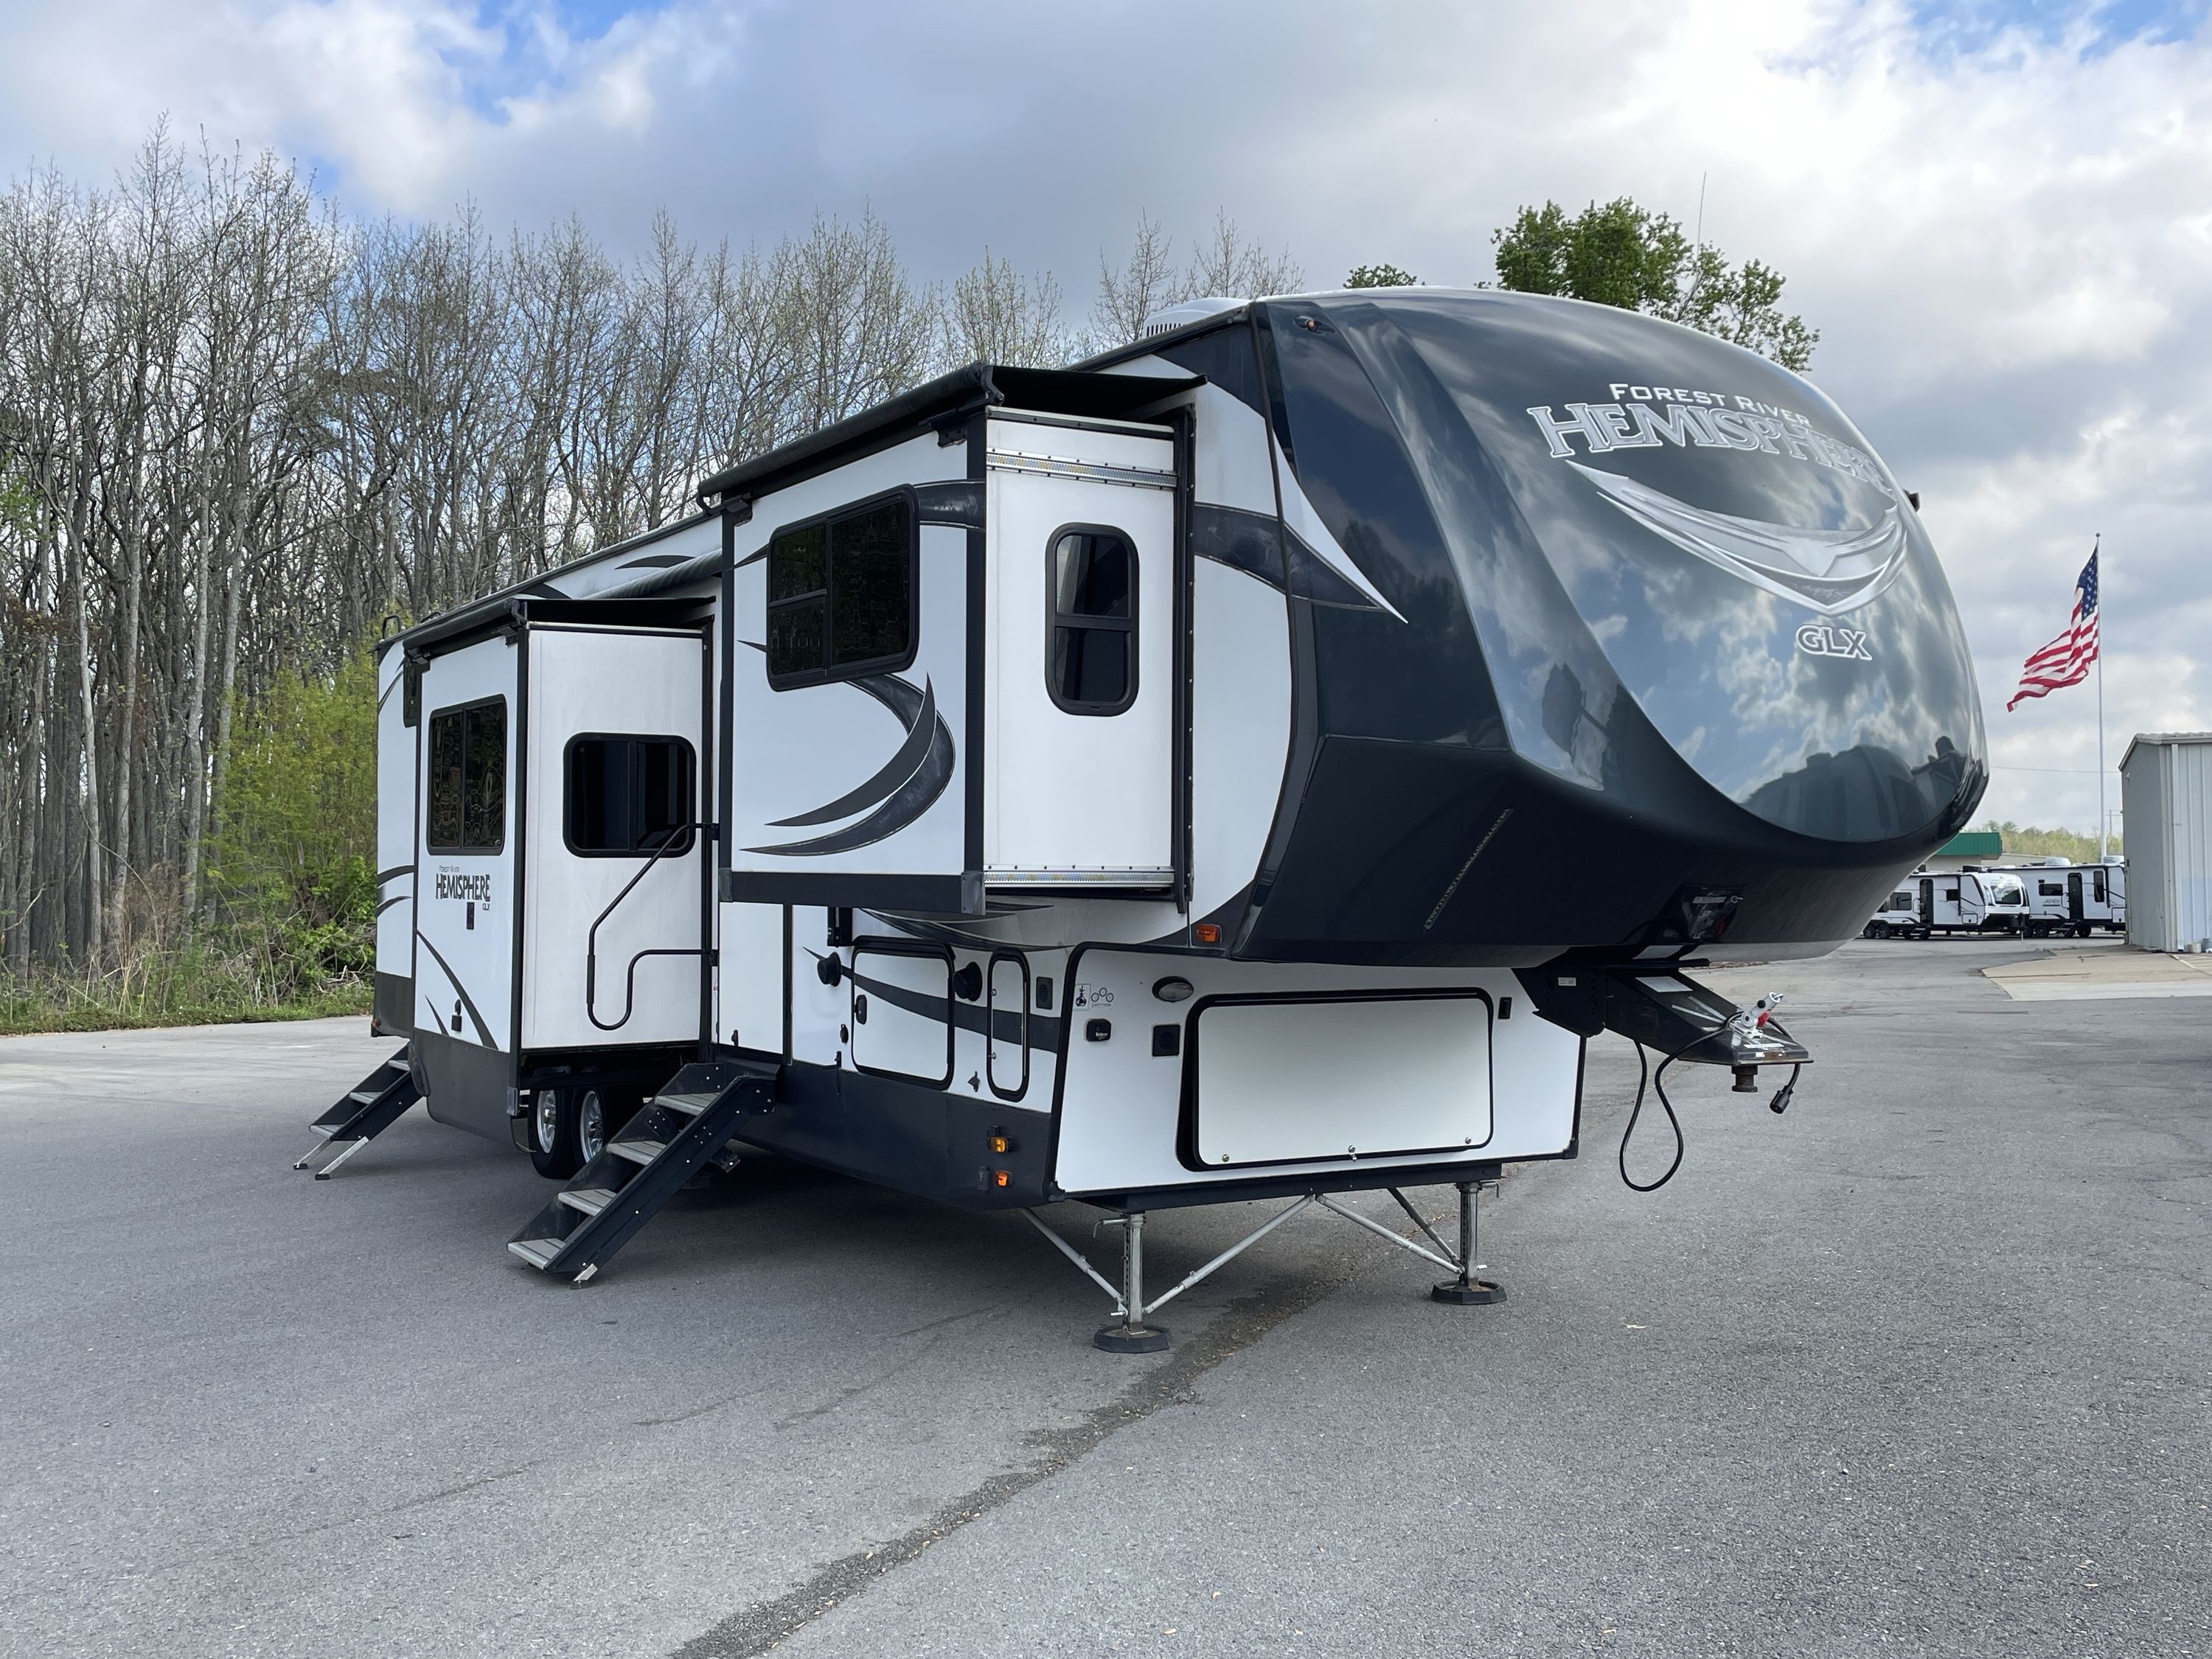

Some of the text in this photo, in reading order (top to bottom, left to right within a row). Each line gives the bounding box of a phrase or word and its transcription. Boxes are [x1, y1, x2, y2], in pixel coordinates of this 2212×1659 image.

[1608, 383, 1812, 428] FOREST RIVER
[1795, 625, 1873, 661] GLX
[436, 873, 490, 902] HEMISPHERE
